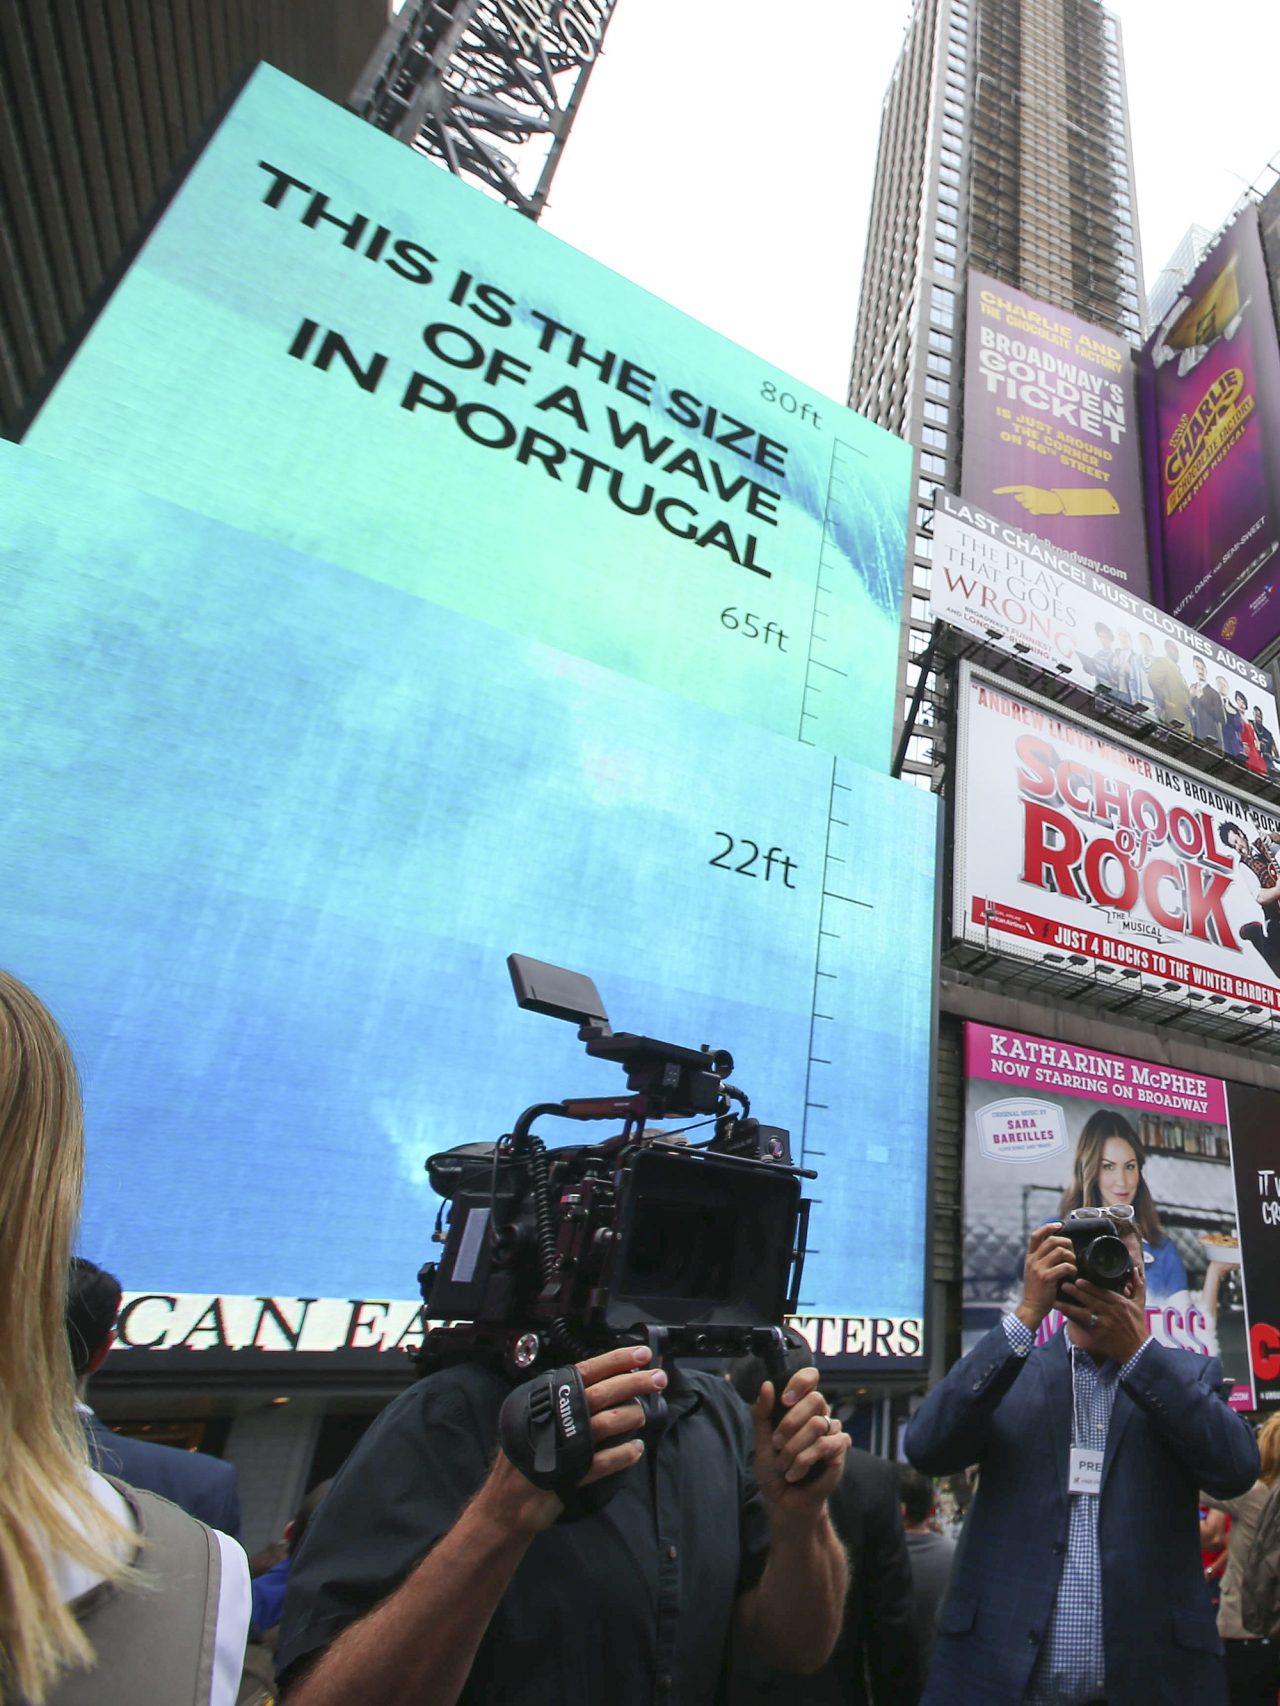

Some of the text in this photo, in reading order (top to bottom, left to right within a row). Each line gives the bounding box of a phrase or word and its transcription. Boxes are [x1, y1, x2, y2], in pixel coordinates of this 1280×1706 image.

[258, 160, 790, 478] THIS IS THE SIZE
[980, 290, 1121, 360] CHARLIE AND
[980, 302, 1123, 374] THE CHOCOLATE FACTORY
[979, 348, 1126, 425] GOLDEN
[980, 326, 1124, 404] BROADWAY'S
[423, 322, 784, 528] OF A WAVE
[760, 381, 825, 433] 80ft
[979, 366, 1126, 444] TICKET
[996, 406, 1113, 461] IS JUST AROUND
[1000, 431, 1023, 446] ON
[1167, 370, 1239, 482] CHARLIE
[287, 317, 773, 579] IN PORTUGAL
[1012, 422, 1099, 466] THE CORNER
[1060, 455, 1111, 482] STREET
[1176, 441, 1219, 498] CHOCOLATE
[1219, 401, 1251, 441] FACTORY
[1193, 471, 1210, 494] NEW
[1211, 425, 1246, 470] MUSICAL
[944, 545, 1077, 628] THAT GOES
[957, 530, 1064, 598] THE PLAY
[1194, 570, 1213, 595] DARK
[1222, 515, 1266, 564] SEMI-SWEET
[943, 567, 1077, 659] WRONG
[944, 496, 1000, 534] LAST
[1003, 529, 1086, 585] CHANCE!
[1092, 578, 1139, 613] MUST
[1142, 607, 1213, 656] CLOTHES
[1216, 650, 1247, 676] AUG
[1250, 669, 1268, 688] 26
[720, 606, 790, 654] 65ft
[1016, 734, 1235, 870] SCHOOL
[1048, 718, 1094, 753] LLOYD
[1155, 767, 1181, 792] HAS
[1184, 783, 1250, 822] BROADWAY
[708, 831, 798, 889] 22ft
[1021, 798, 1242, 952] ROCK
[1115, 825, 1152, 869] of
[1112, 911, 1126, 920] THE
[1122, 921, 1163, 938] MUSICAL
[1054, 926, 1088, 950] JUST
[1091, 937, 1099, 954] 4
[1103, 940, 1149, 969] BLOCKS
[1152, 954, 1166, 974] TO
[1169, 959, 1190, 980] THE
[1192, 966, 1234, 995] WINTER
[1235, 979, 1275, 1004] GARDEN
[990, 1034, 1207, 1098] KATHARINE McPHEE
[991, 1059, 1208, 1114] NOW STARRING ON BROADWAY
[993, 1130, 1054, 1144] BAREILLES
[1007, 1119, 1037, 1130] SARA
[1257, 1170, 1275, 1196] IT
[558, 1384, 577, 1438] Canon
